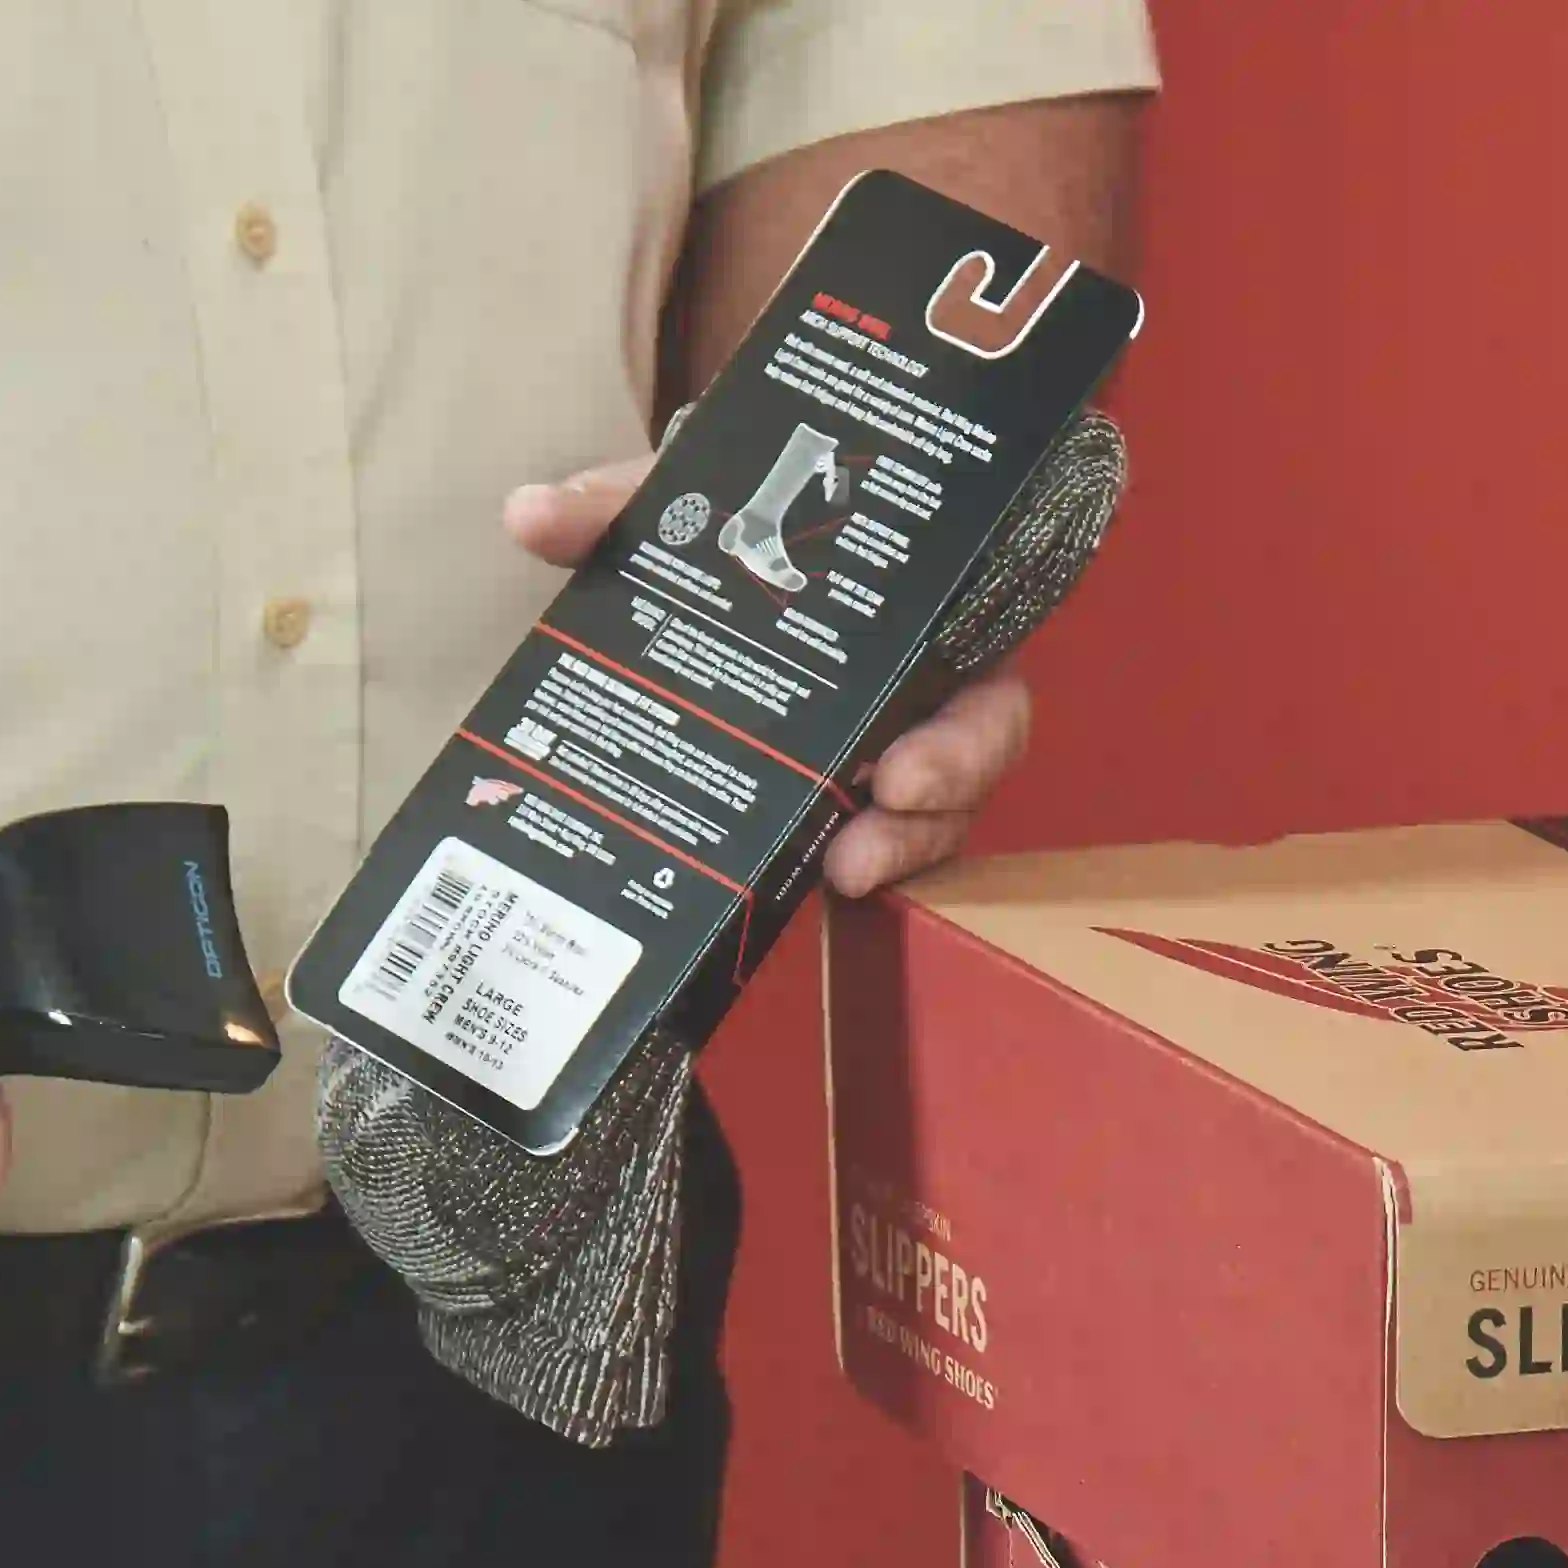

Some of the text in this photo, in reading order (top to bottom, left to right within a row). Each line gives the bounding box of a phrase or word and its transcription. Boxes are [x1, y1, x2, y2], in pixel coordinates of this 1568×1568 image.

[183, 859, 223, 979] OPTICON
[420, 891, 520, 1024] MERINO LIGHT CREW
[462, 998, 528, 1042] SHOE SIZES
[476, 982, 524, 1016] LARGE
[1264, 939, 1525, 1052] RED WING
[850, 1202, 988, 1353] SLIPPERS
[900, 1325, 941, 1376] WING
[944, 1355, 994, 1411] SHOES
